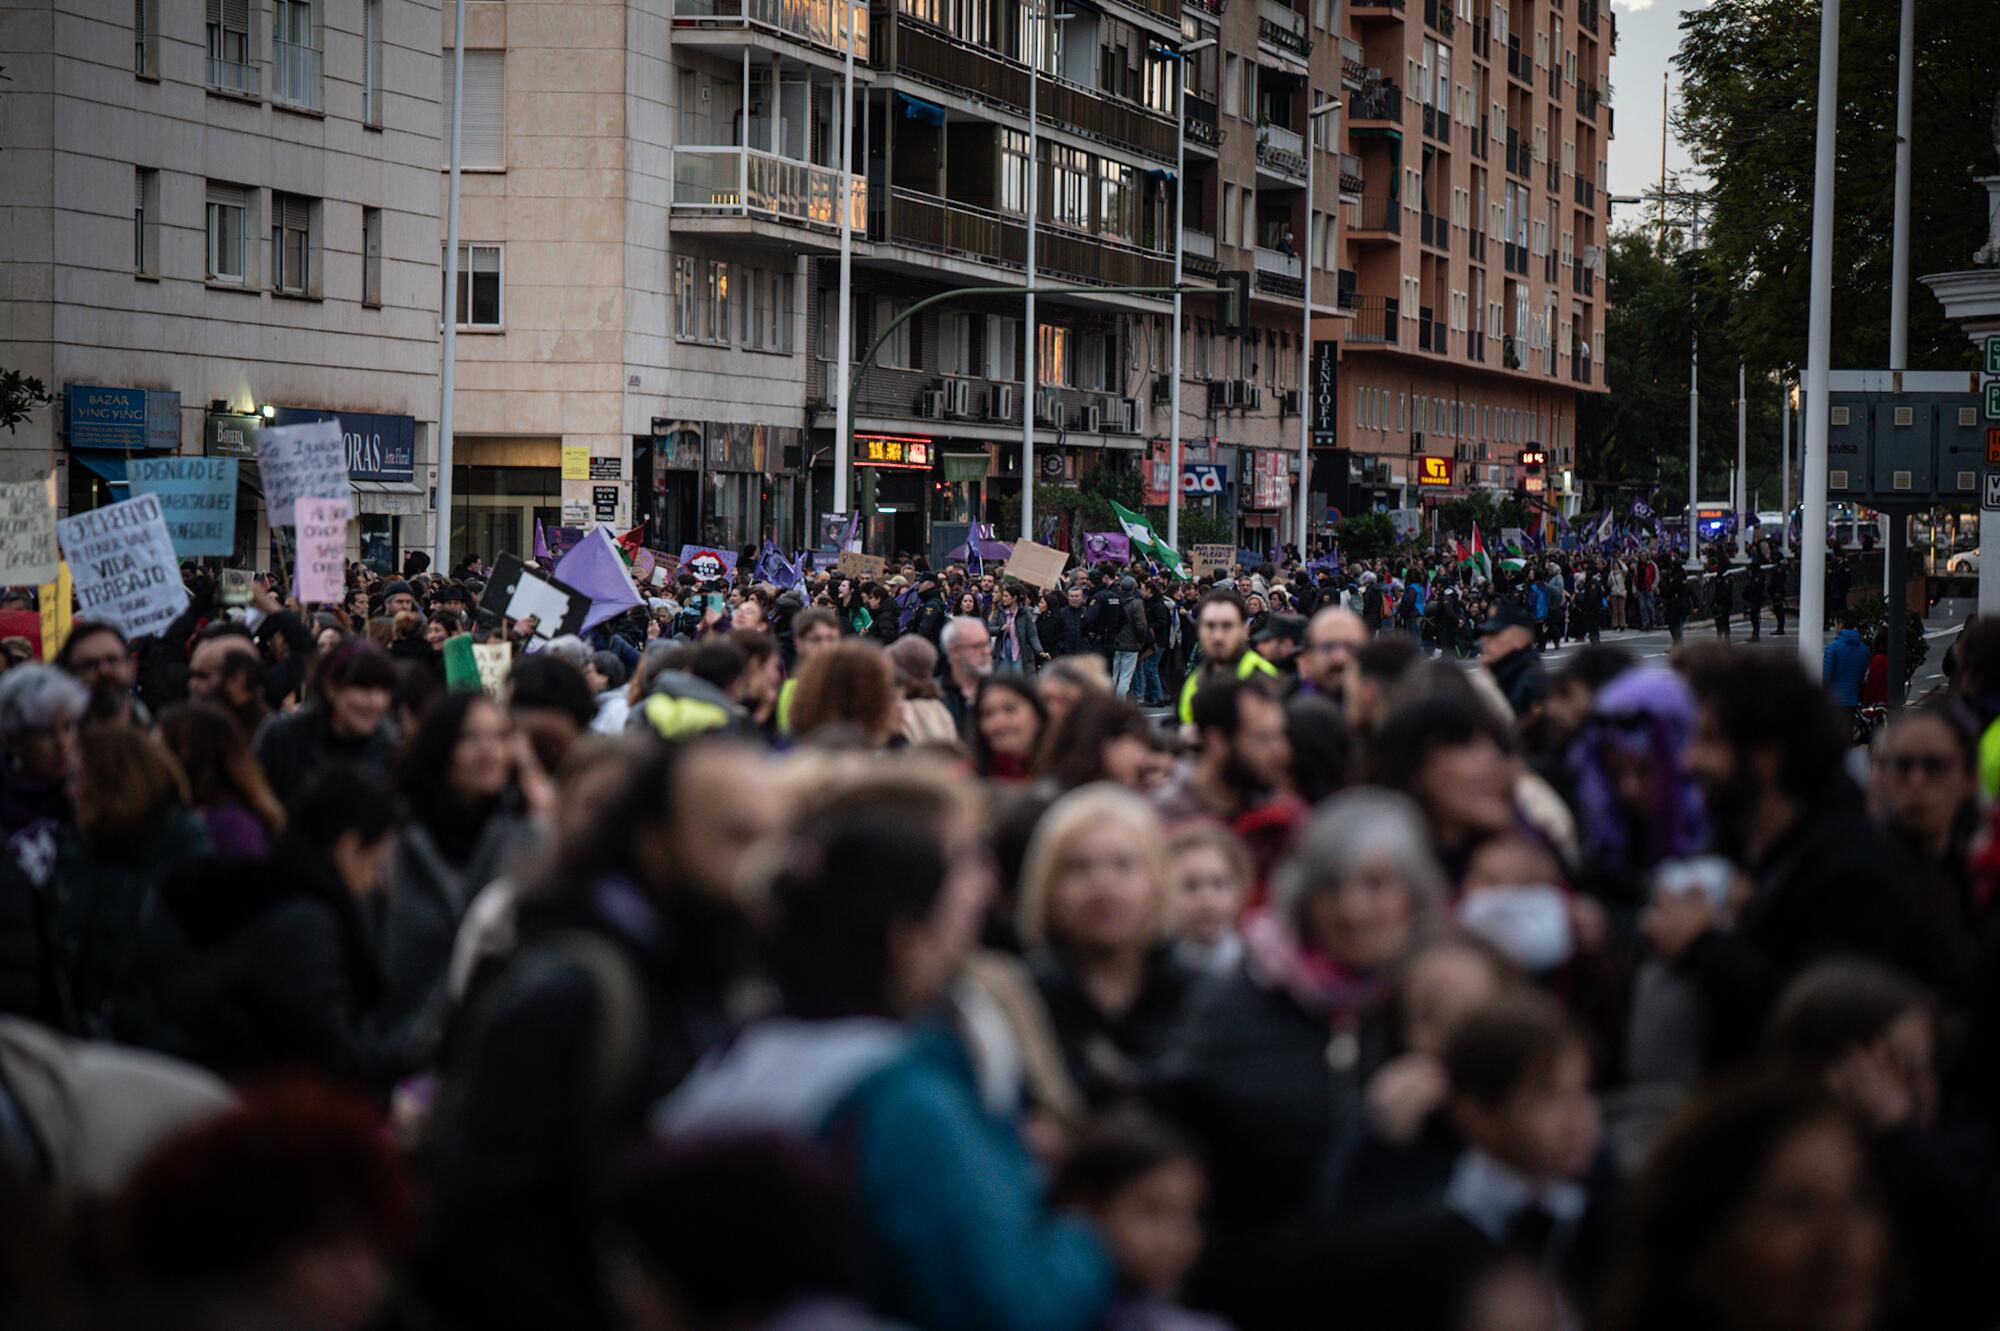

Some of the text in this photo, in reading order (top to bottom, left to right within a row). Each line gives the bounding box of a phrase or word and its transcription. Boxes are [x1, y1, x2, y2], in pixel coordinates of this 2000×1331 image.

[88, 394, 130, 406] BAZAR
[1319, 344, 1331, 428] JENTOFT
[342, 432, 381, 473] ORAS
[90, 552, 137, 579] VIDA
[80, 565, 166, 608] TRABAJO
